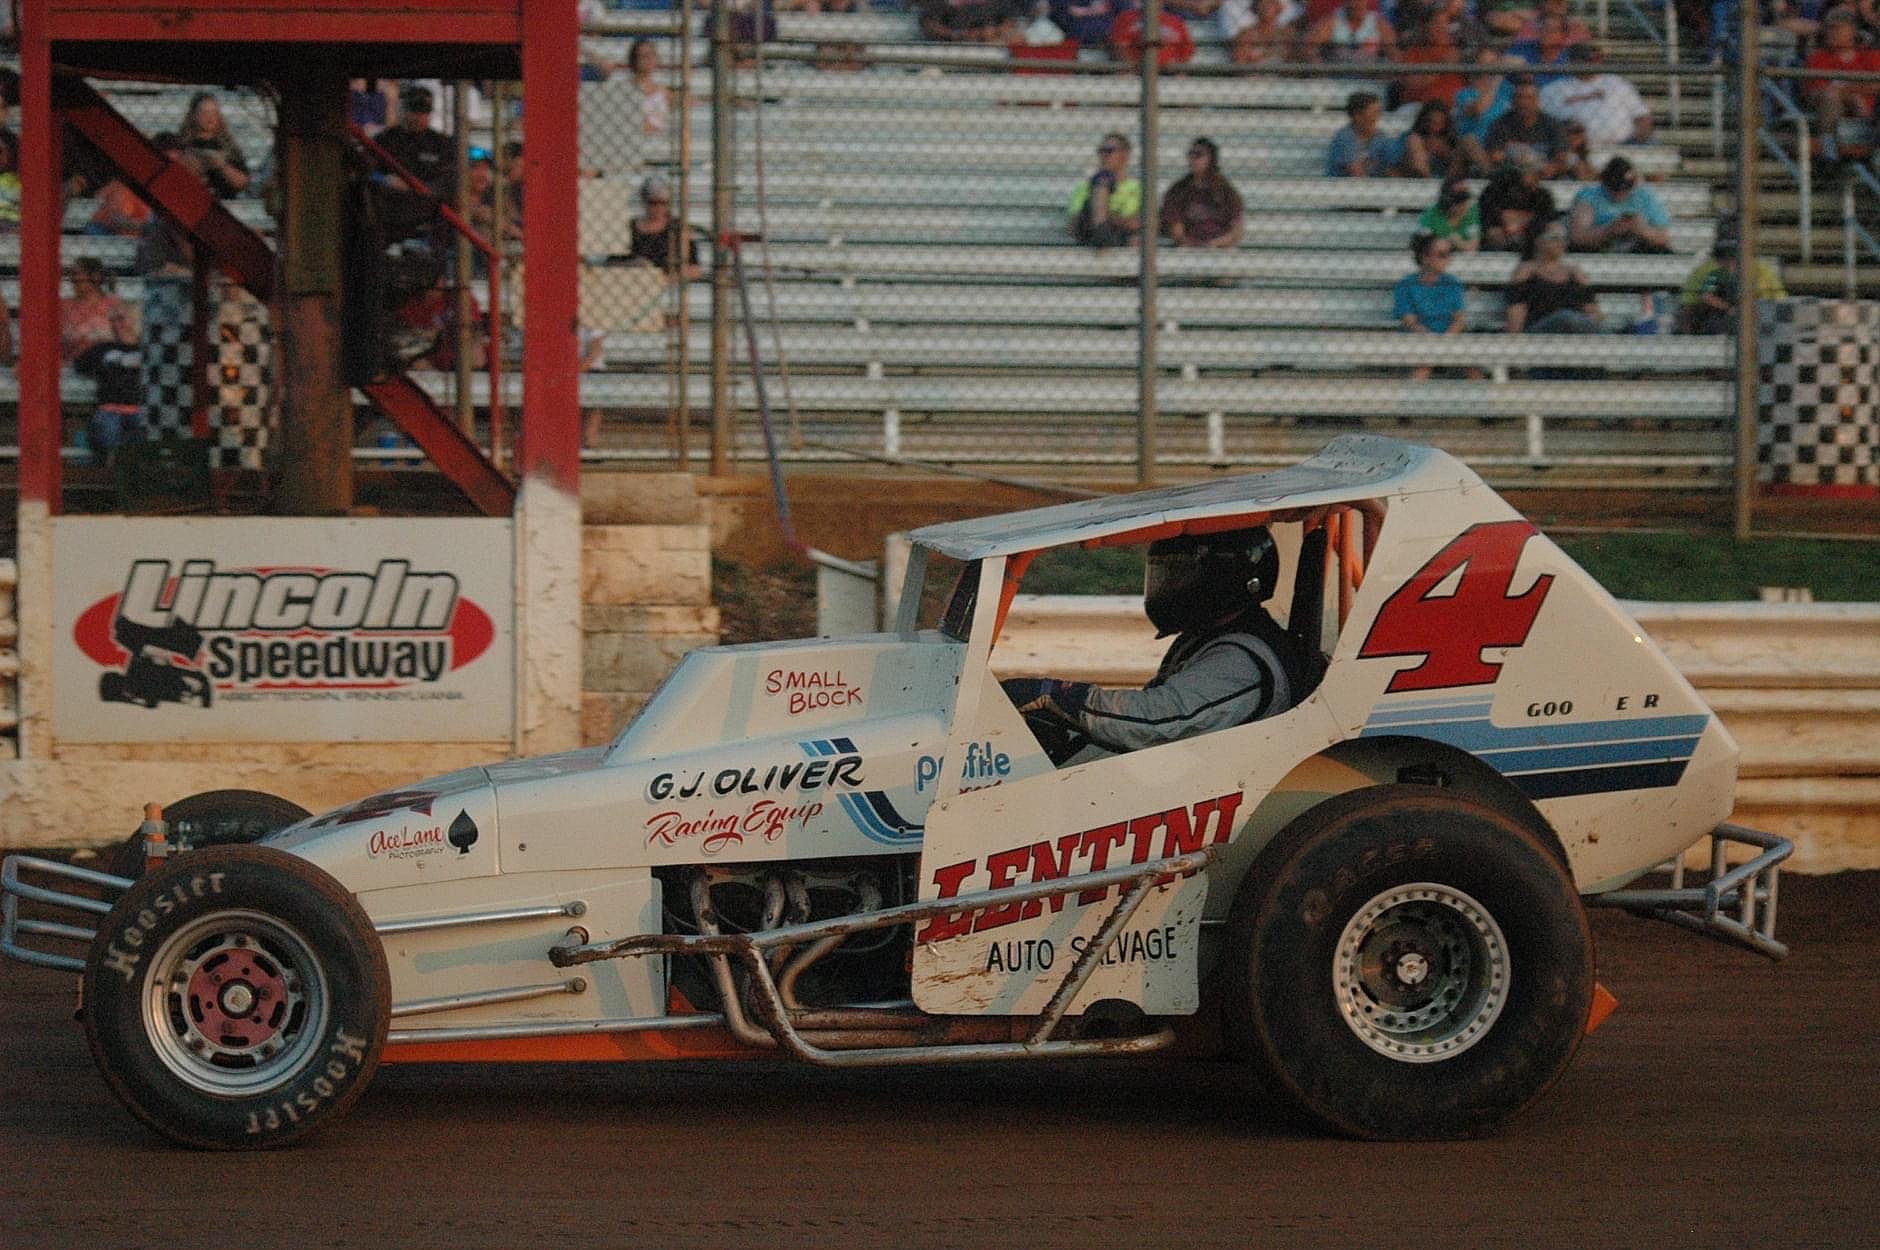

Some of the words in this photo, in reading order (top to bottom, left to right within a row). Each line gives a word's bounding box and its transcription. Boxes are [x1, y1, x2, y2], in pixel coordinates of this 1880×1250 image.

[115, 560, 459, 630] Lincoln
[1356, 520, 1556, 694] 4
[208, 636, 446, 682] Speedway
[766, 670, 847, 694] SMALL
[789, 687, 863, 714] BLOCK
[714, 756, 865, 796] OLIVER
[917, 741, 1011, 792] pfile
[647, 810, 743, 854] Racing
[917, 791, 1243, 943] LENTINI
[986, 938, 1054, 972] AUTO
[1071, 926, 1177, 967] SLVAGE
